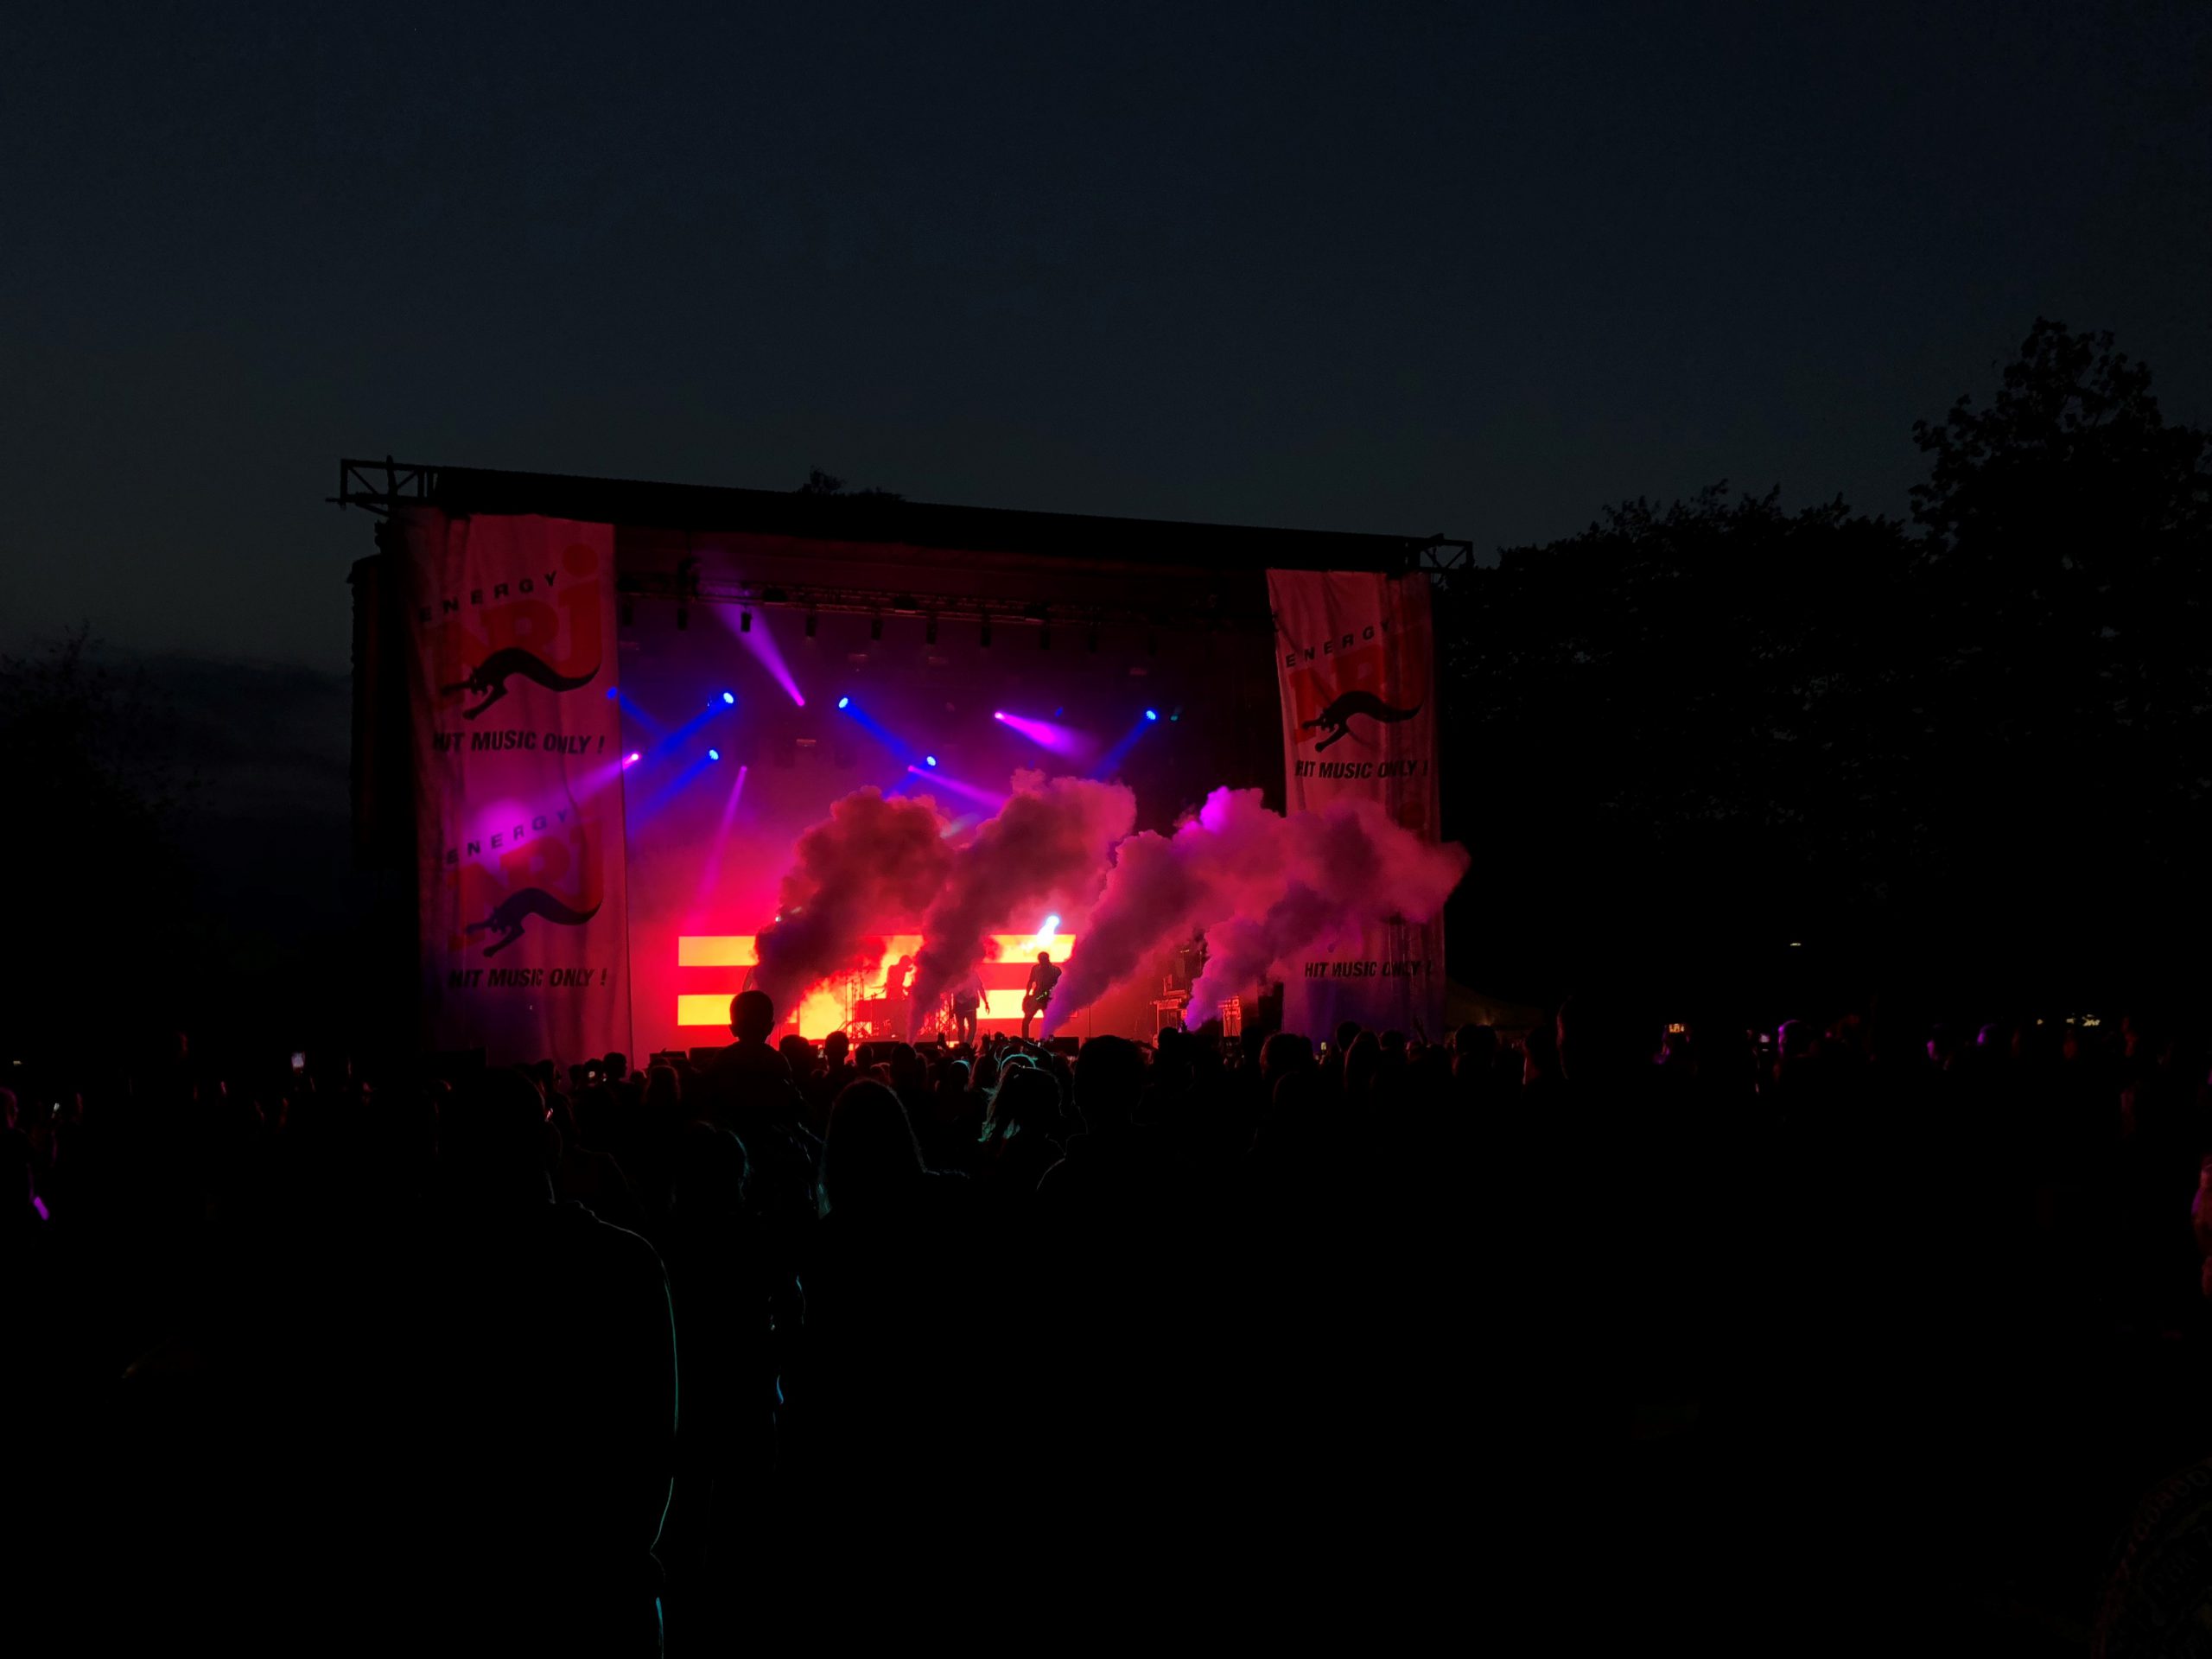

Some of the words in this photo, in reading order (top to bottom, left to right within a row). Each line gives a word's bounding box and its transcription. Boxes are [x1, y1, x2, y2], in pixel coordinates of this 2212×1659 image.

[419, 570, 557, 622] ENERGY
[1286, 618, 1391, 667] ENERGY
[471, 730, 537, 752] MUSIC
[543, 733, 591, 754] ONLY
[599, 734, 606, 753] !
[1295, 760, 1316, 777] HIT
[1319, 761, 1373, 779] MUSIC
[1378, 760, 1418, 778] ONLY
[446, 808, 570, 864] ENERGY
[448, 968, 484, 988] HIT
[487, 968, 544, 988] MUSIC
[550, 968, 594, 988] ONLY
[601, 968, 607, 986] !
[1305, 962, 1329, 977] HIT
[1332, 961, 1377, 977] MUSIC
[1382, 961, 1421, 977] ONLY
